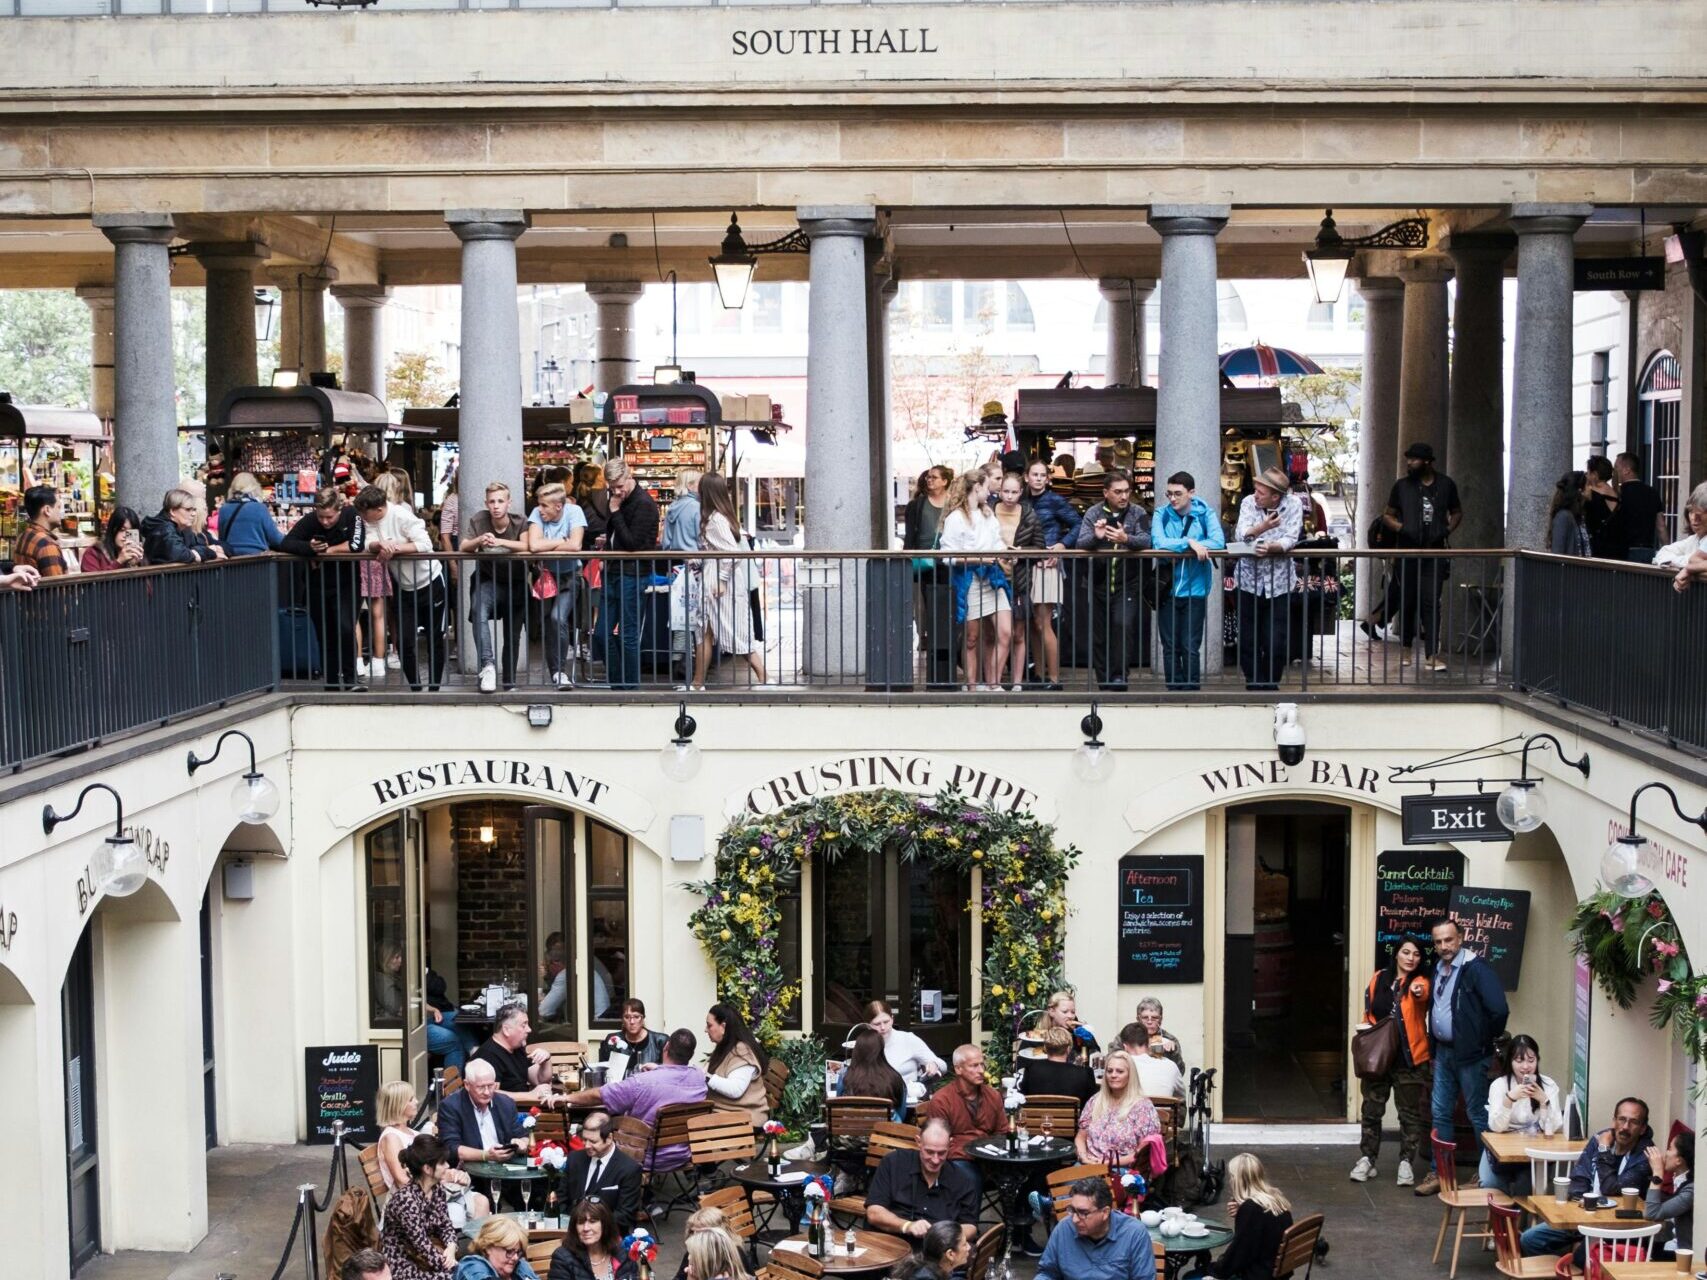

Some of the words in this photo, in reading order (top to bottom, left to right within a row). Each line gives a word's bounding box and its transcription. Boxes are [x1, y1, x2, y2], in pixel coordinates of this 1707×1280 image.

[732, 29, 841, 56] SOUTH
[850, 28, 939, 54] HALL
[1586, 269, 1616, 281] South
[1618, 269, 1641, 280] Row
[370, 759, 610, 806] RESTAURANT
[1201, 759, 1289, 794] WINE
[1308, 759, 1380, 794] BAR
[746, 756, 931, 815] CRUSTING
[952, 764, 1039, 813] PIPE
[1431, 806, 1486, 830] Exit
[1407, 864, 1455, 880] Cocktails
[1665, 848, 1688, 889] CAFE
[1126, 870, 1177, 885] Afternoon
[1132, 888, 1154, 904] Tea
[1458, 894, 1470, 905] The
[1124, 911, 1140, 920] Enjoy
[1146, 911, 1175, 920] selection
[1176, 911, 1184, 919] of
[1180, 918, 1193, 926] and
[1449, 911, 1475, 927] Please
[1476, 912, 1493, 928] Wait
[1492, 913, 1513, 930] Here
[1463, 927, 1475, 942] To
[1475, 927, 1490, 944] Be
[322, 1051, 362, 1066] Jude's
[320, 1100, 351, 1109] Coconut
